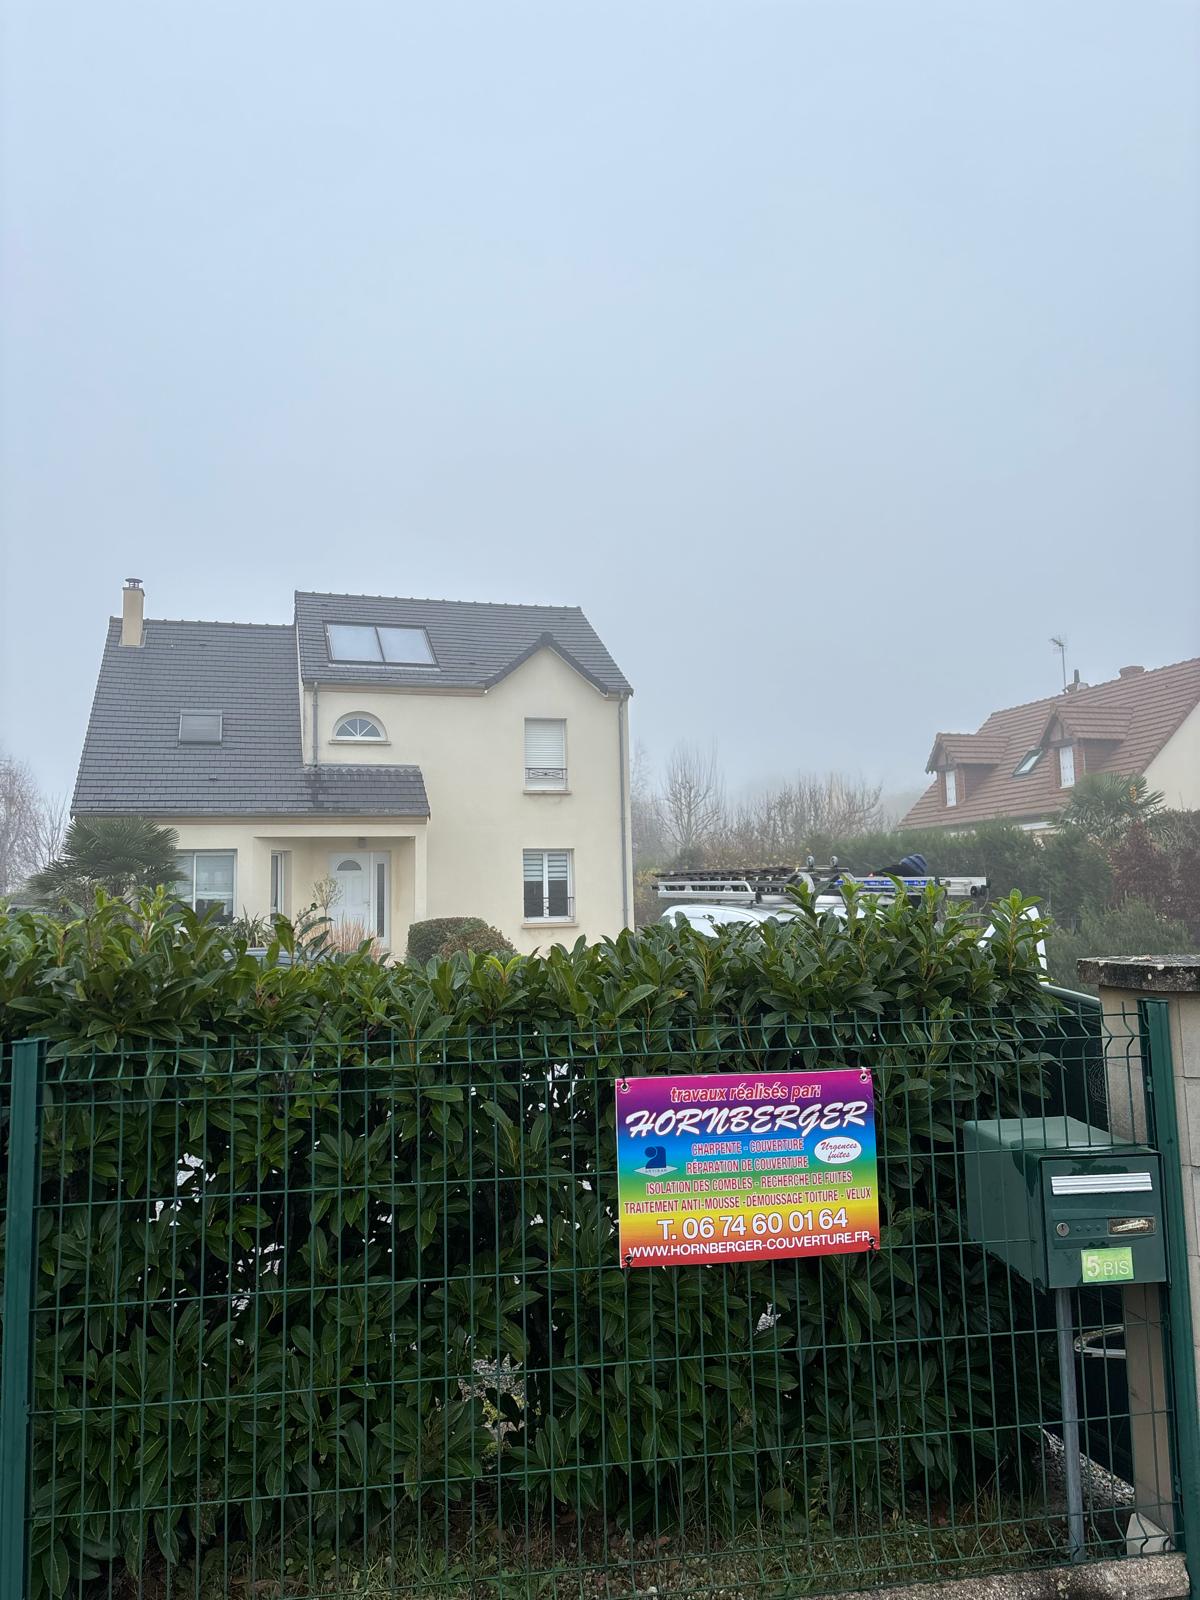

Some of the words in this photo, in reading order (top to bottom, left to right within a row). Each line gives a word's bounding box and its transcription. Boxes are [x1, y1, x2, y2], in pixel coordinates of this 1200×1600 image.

[671, 1087, 727, 1102] travaux
[730, 1082, 788, 1100] réalisés
[625, 1101, 868, 1138] HORNBERGER
[692, 1141, 742, 1155] CHARPENTE
[751, 1138, 804, 1153] COUVERTURE
[820, 1141, 857, 1152] Urgences
[828, 1152, 850, 1161] fuites
[686, 1158, 739, 1175] RÉPARATION
[742, 1158, 753, 1171] DE
[755, 1156, 809, 1172] COUVERTURE
[646, 1181, 691, 1195] ISOLATION
[693, 1180, 710, 1193] DES
[712, 1176, 753, 1191] COMBLES
[761, 1173, 809, 1188] RECHERCHE
[812, 1172, 823, 1185] DE
[825, 1171, 853, 1184] FUITES
[625, 1200, 679, 1214] TRAITEMENT
[681, 1196, 740, 1211] ANTI-MOUSSE
[805, 1189, 838, 1203] TOITURE
[846, 1187, 872, 1200] VELUX
[657, 1218, 677, 1240] T.
[682, 1216, 715, 1239] 06
[719, 1214, 747, 1237] 74
[752, 1211, 783, 1235] 60
[789, 1209, 813, 1232] 01
[818, 1207, 848, 1230] 64
[628, 1231, 870, 1258] WWW.HORNBERGER-COUVERTURE.FR
[1087, 1255, 1101, 1277] 5
[1103, 1260, 1130, 1276] BIS
